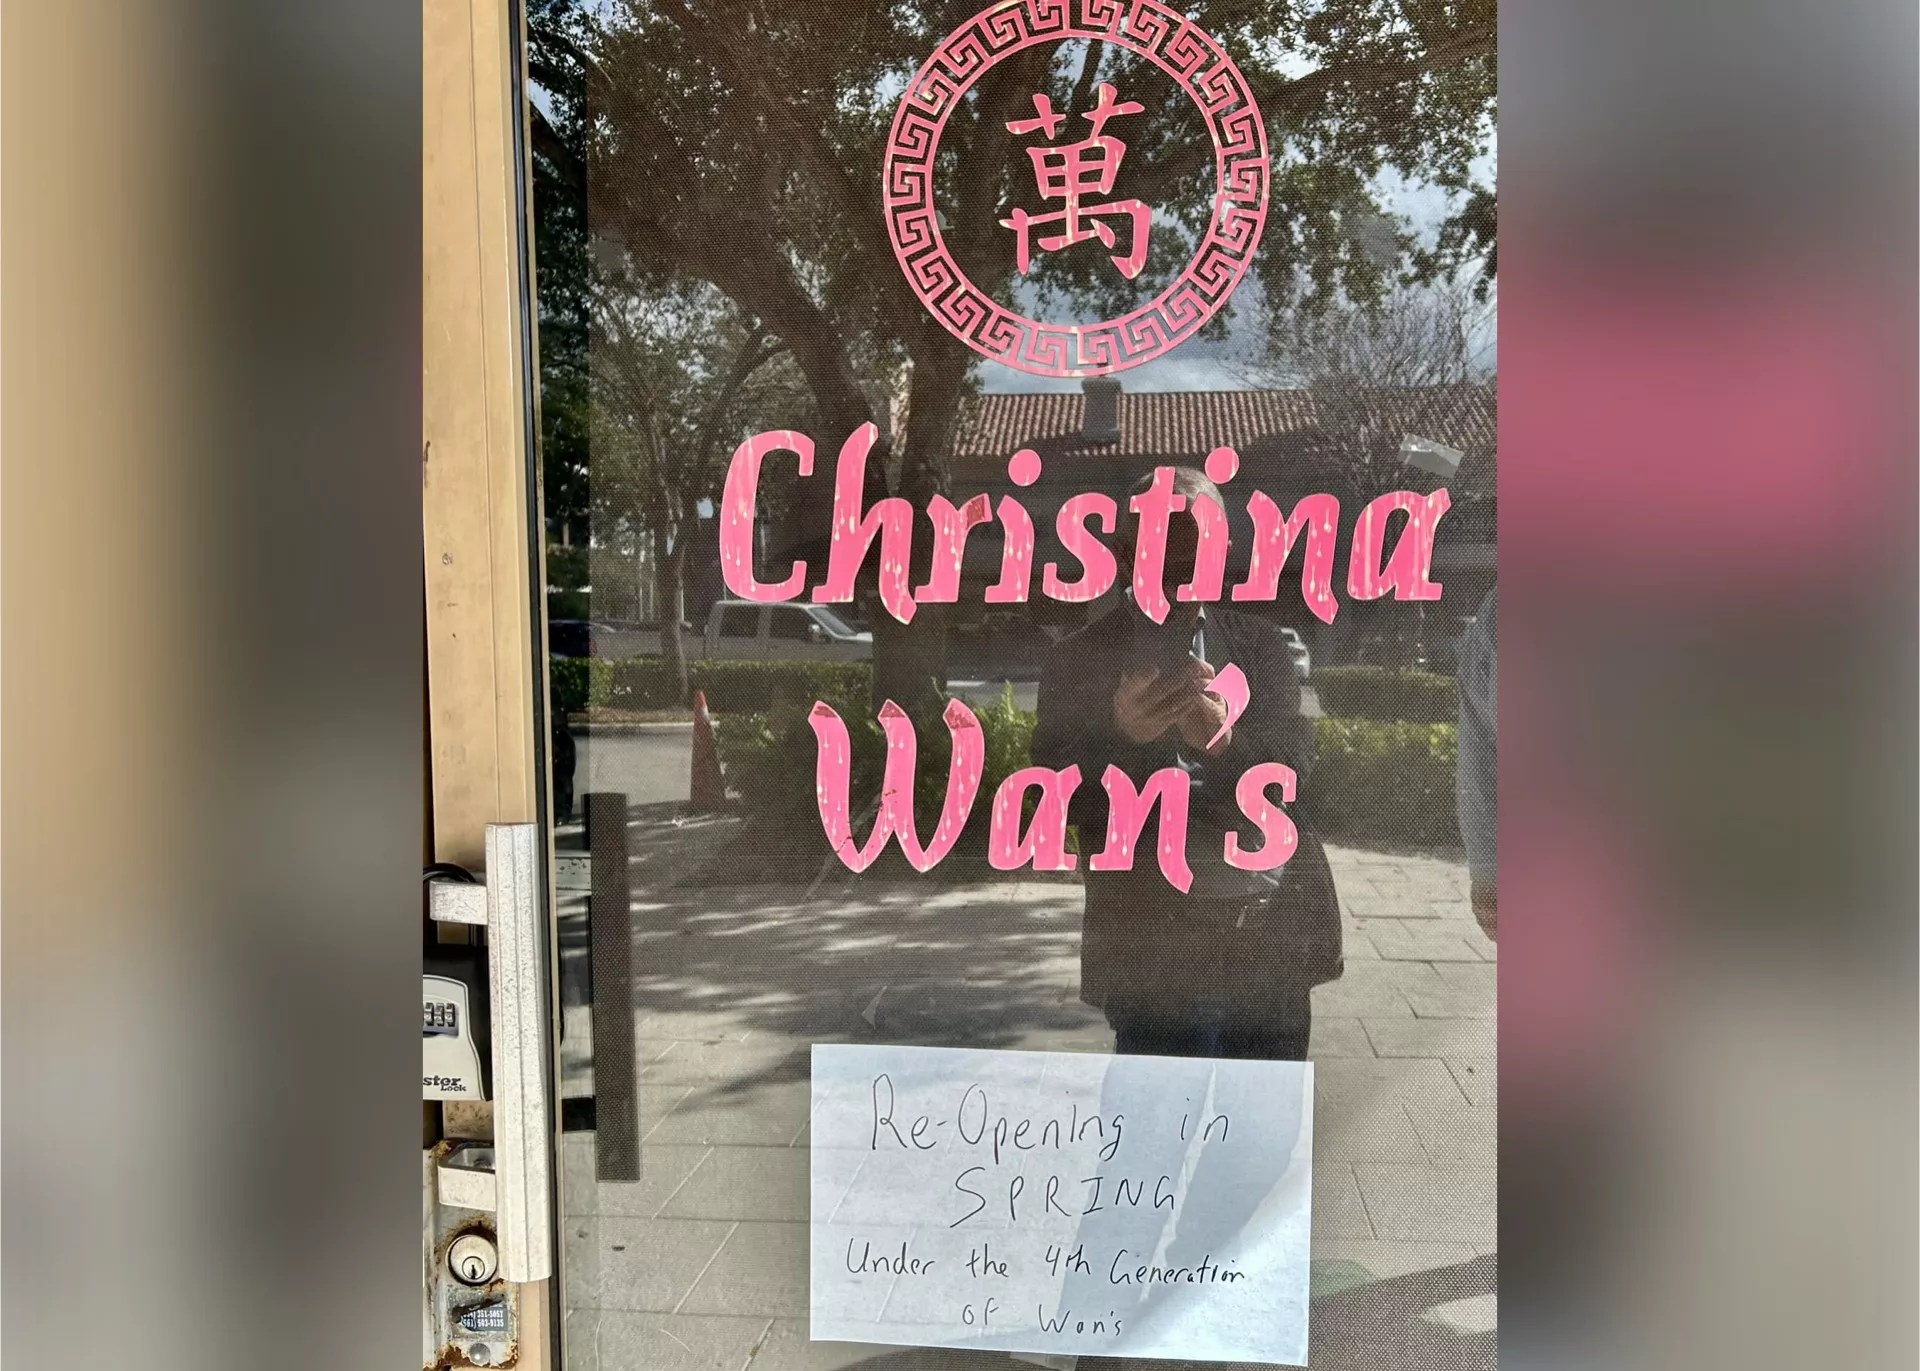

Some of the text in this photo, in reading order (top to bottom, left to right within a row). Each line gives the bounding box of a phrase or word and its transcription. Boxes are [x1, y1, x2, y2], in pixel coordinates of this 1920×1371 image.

[999, 82, 1152, 280] 萬
[719, 421, 1451, 625] Christina
[808, 662, 1299, 894] Wan's
[871, 1073, 1230, 1164] Re-Opening in
[846, 1237, 1246, 1285] Under the 4th Generation
[950, 1166, 1175, 1228] SPRING
